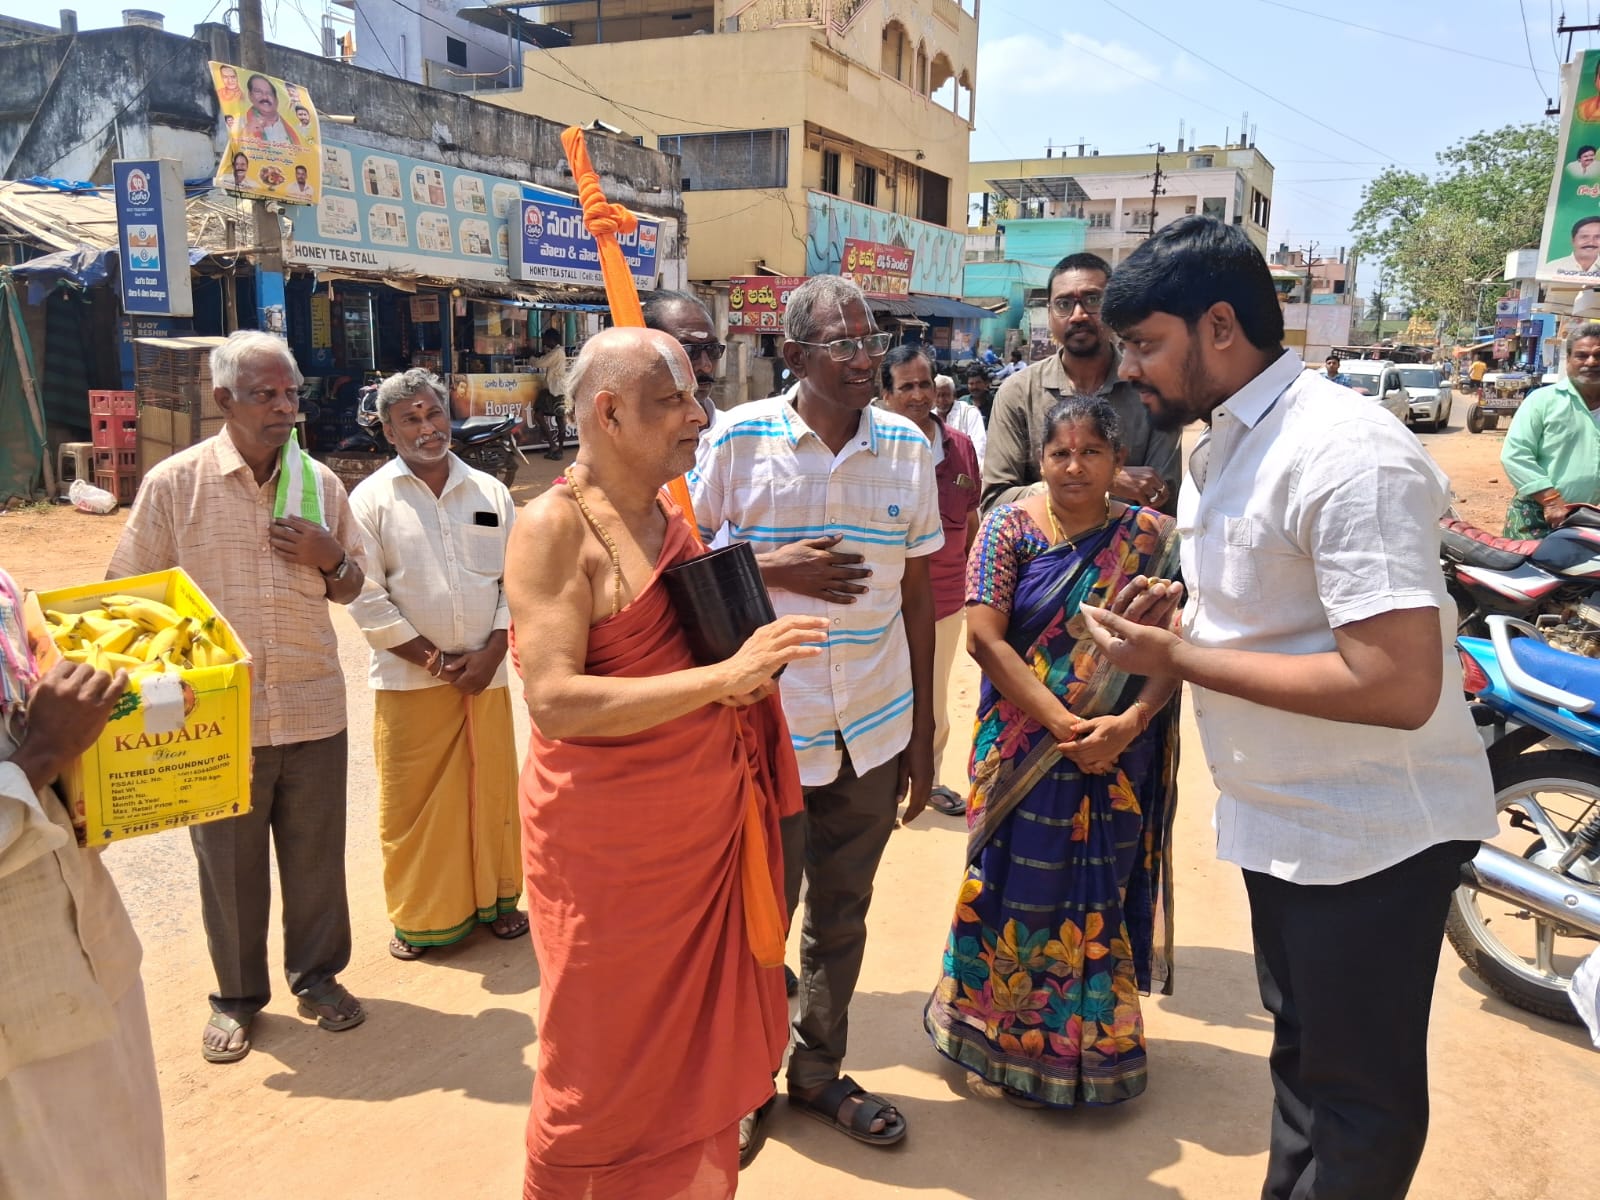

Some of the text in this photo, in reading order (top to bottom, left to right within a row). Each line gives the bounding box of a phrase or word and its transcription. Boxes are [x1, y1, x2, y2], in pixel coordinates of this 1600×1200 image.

[294, 245, 378, 264] HONEY TEA STALL
[540, 243, 566, 258] పాలు
[568, 246, 576, 260] &
[848, 246, 858, 271] శ్రీ
[859, 248, 876, 272] అమ్మ
[530, 266, 548, 277] HONEY
[550, 267, 560, 278] TEA
[560, 268, 577, 280] STALL
[582, 270, 594, 282] Cell:
[730, 286, 745, 310] శ్రీ
[748, 285, 778, 310] అమ్మ
[485, 400, 522, 416] Honey
[114, 720, 222, 752] KADAPA
[109, 768, 156, 780] FILTERED
[158, 757, 215, 773] GROUNDNUT
[218, 753, 231, 761] OIL
[112, 800, 136, 808] Month
[122, 823, 160, 834] THIS
[164, 813, 200, 824] SIDE
[205, 809, 224, 817] UP
